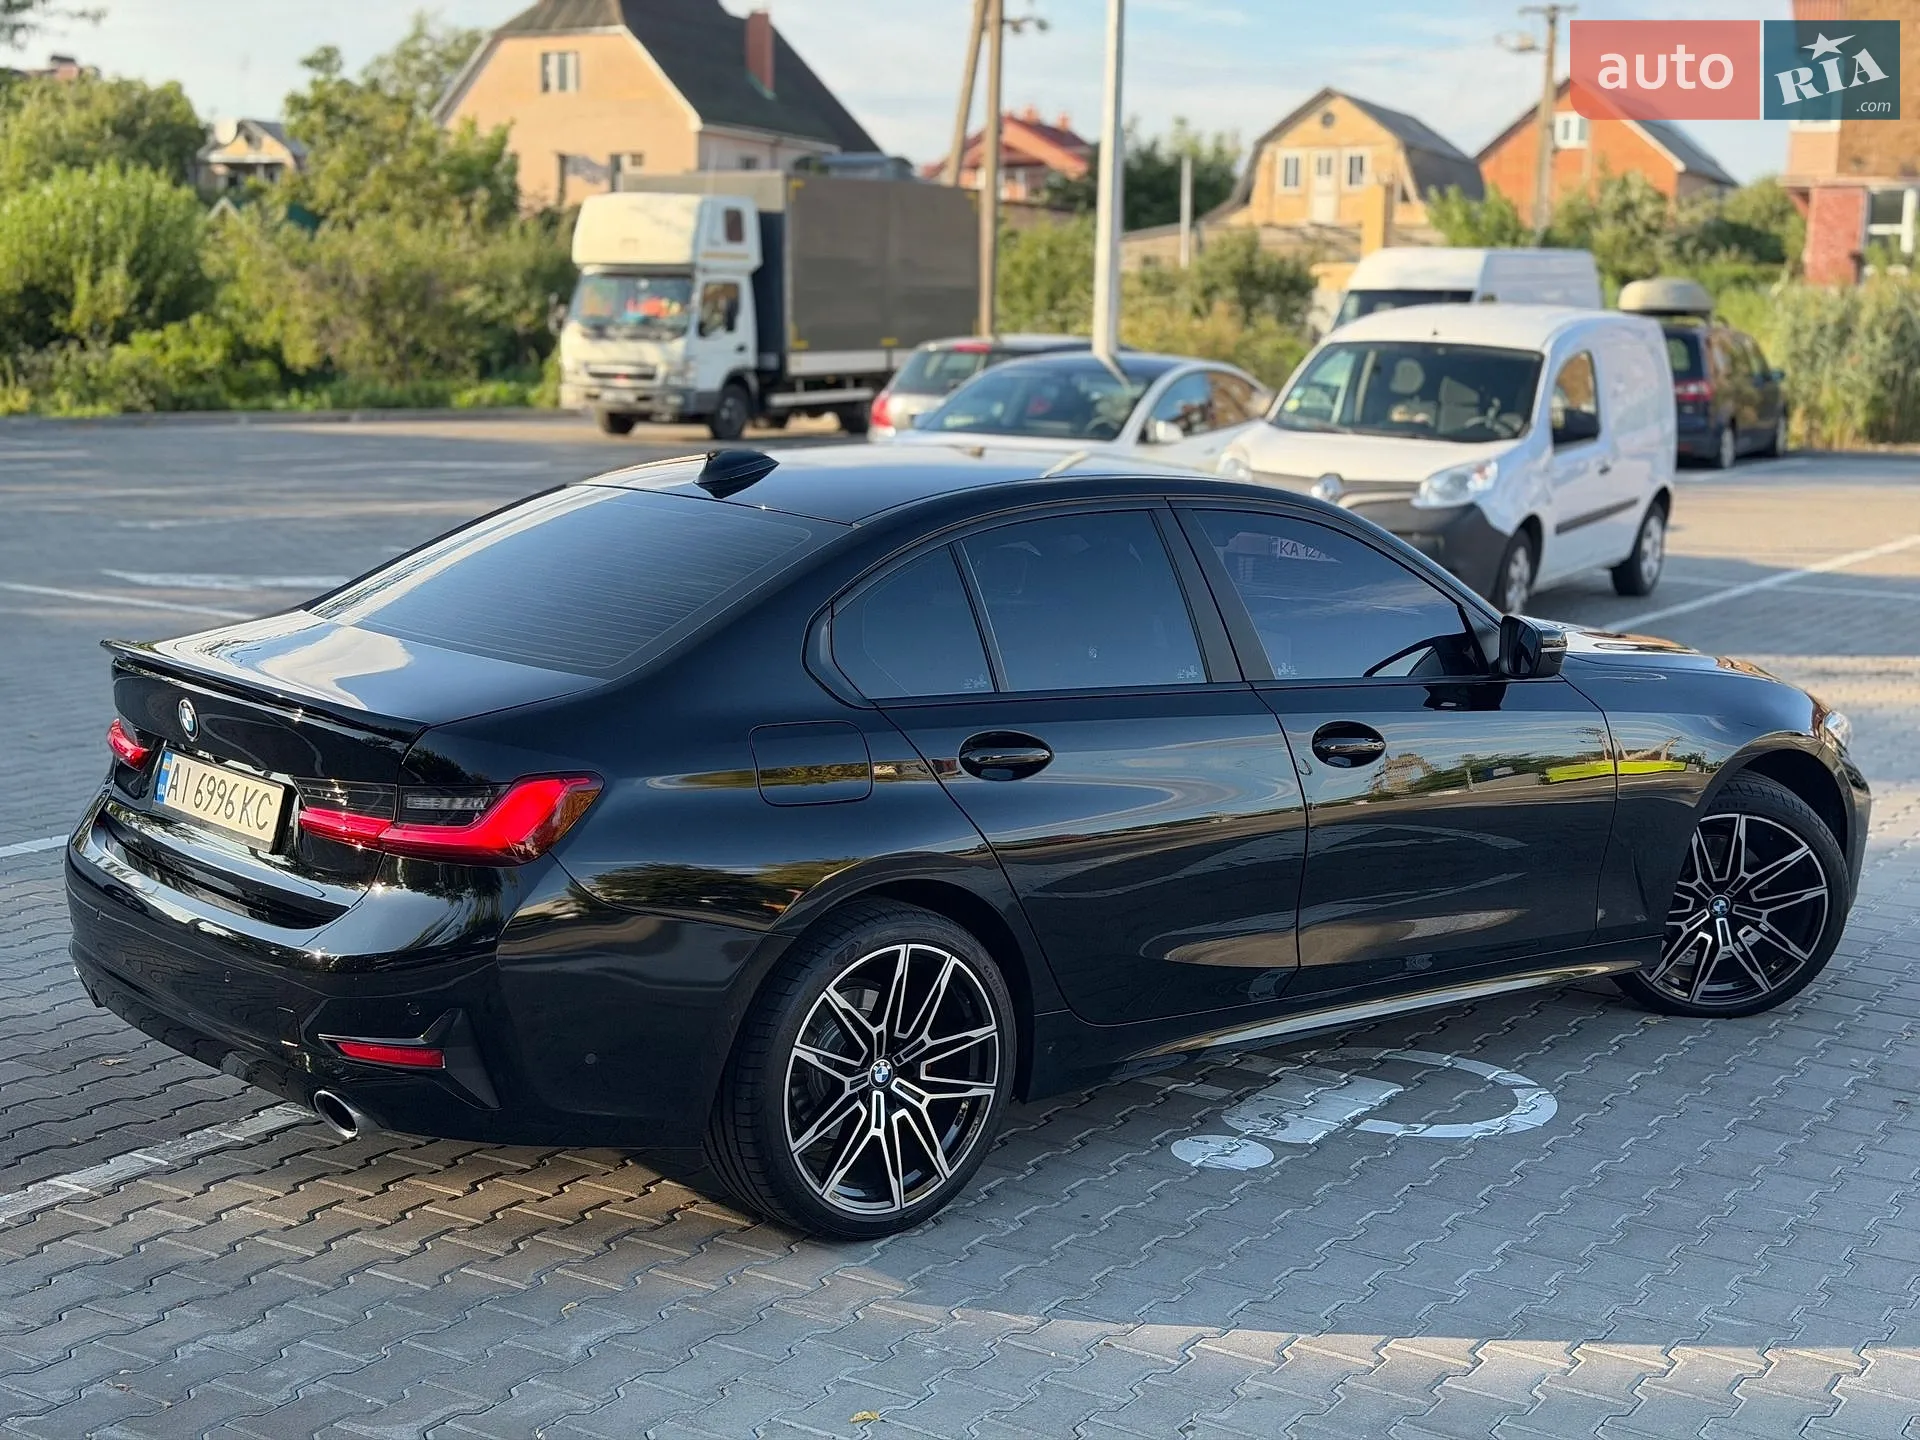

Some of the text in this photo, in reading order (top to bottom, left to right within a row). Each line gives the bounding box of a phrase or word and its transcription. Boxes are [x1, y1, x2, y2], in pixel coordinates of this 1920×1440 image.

[1279, 541, 1299, 557] KA
[167, 763, 272, 831] AI 6996 KC
